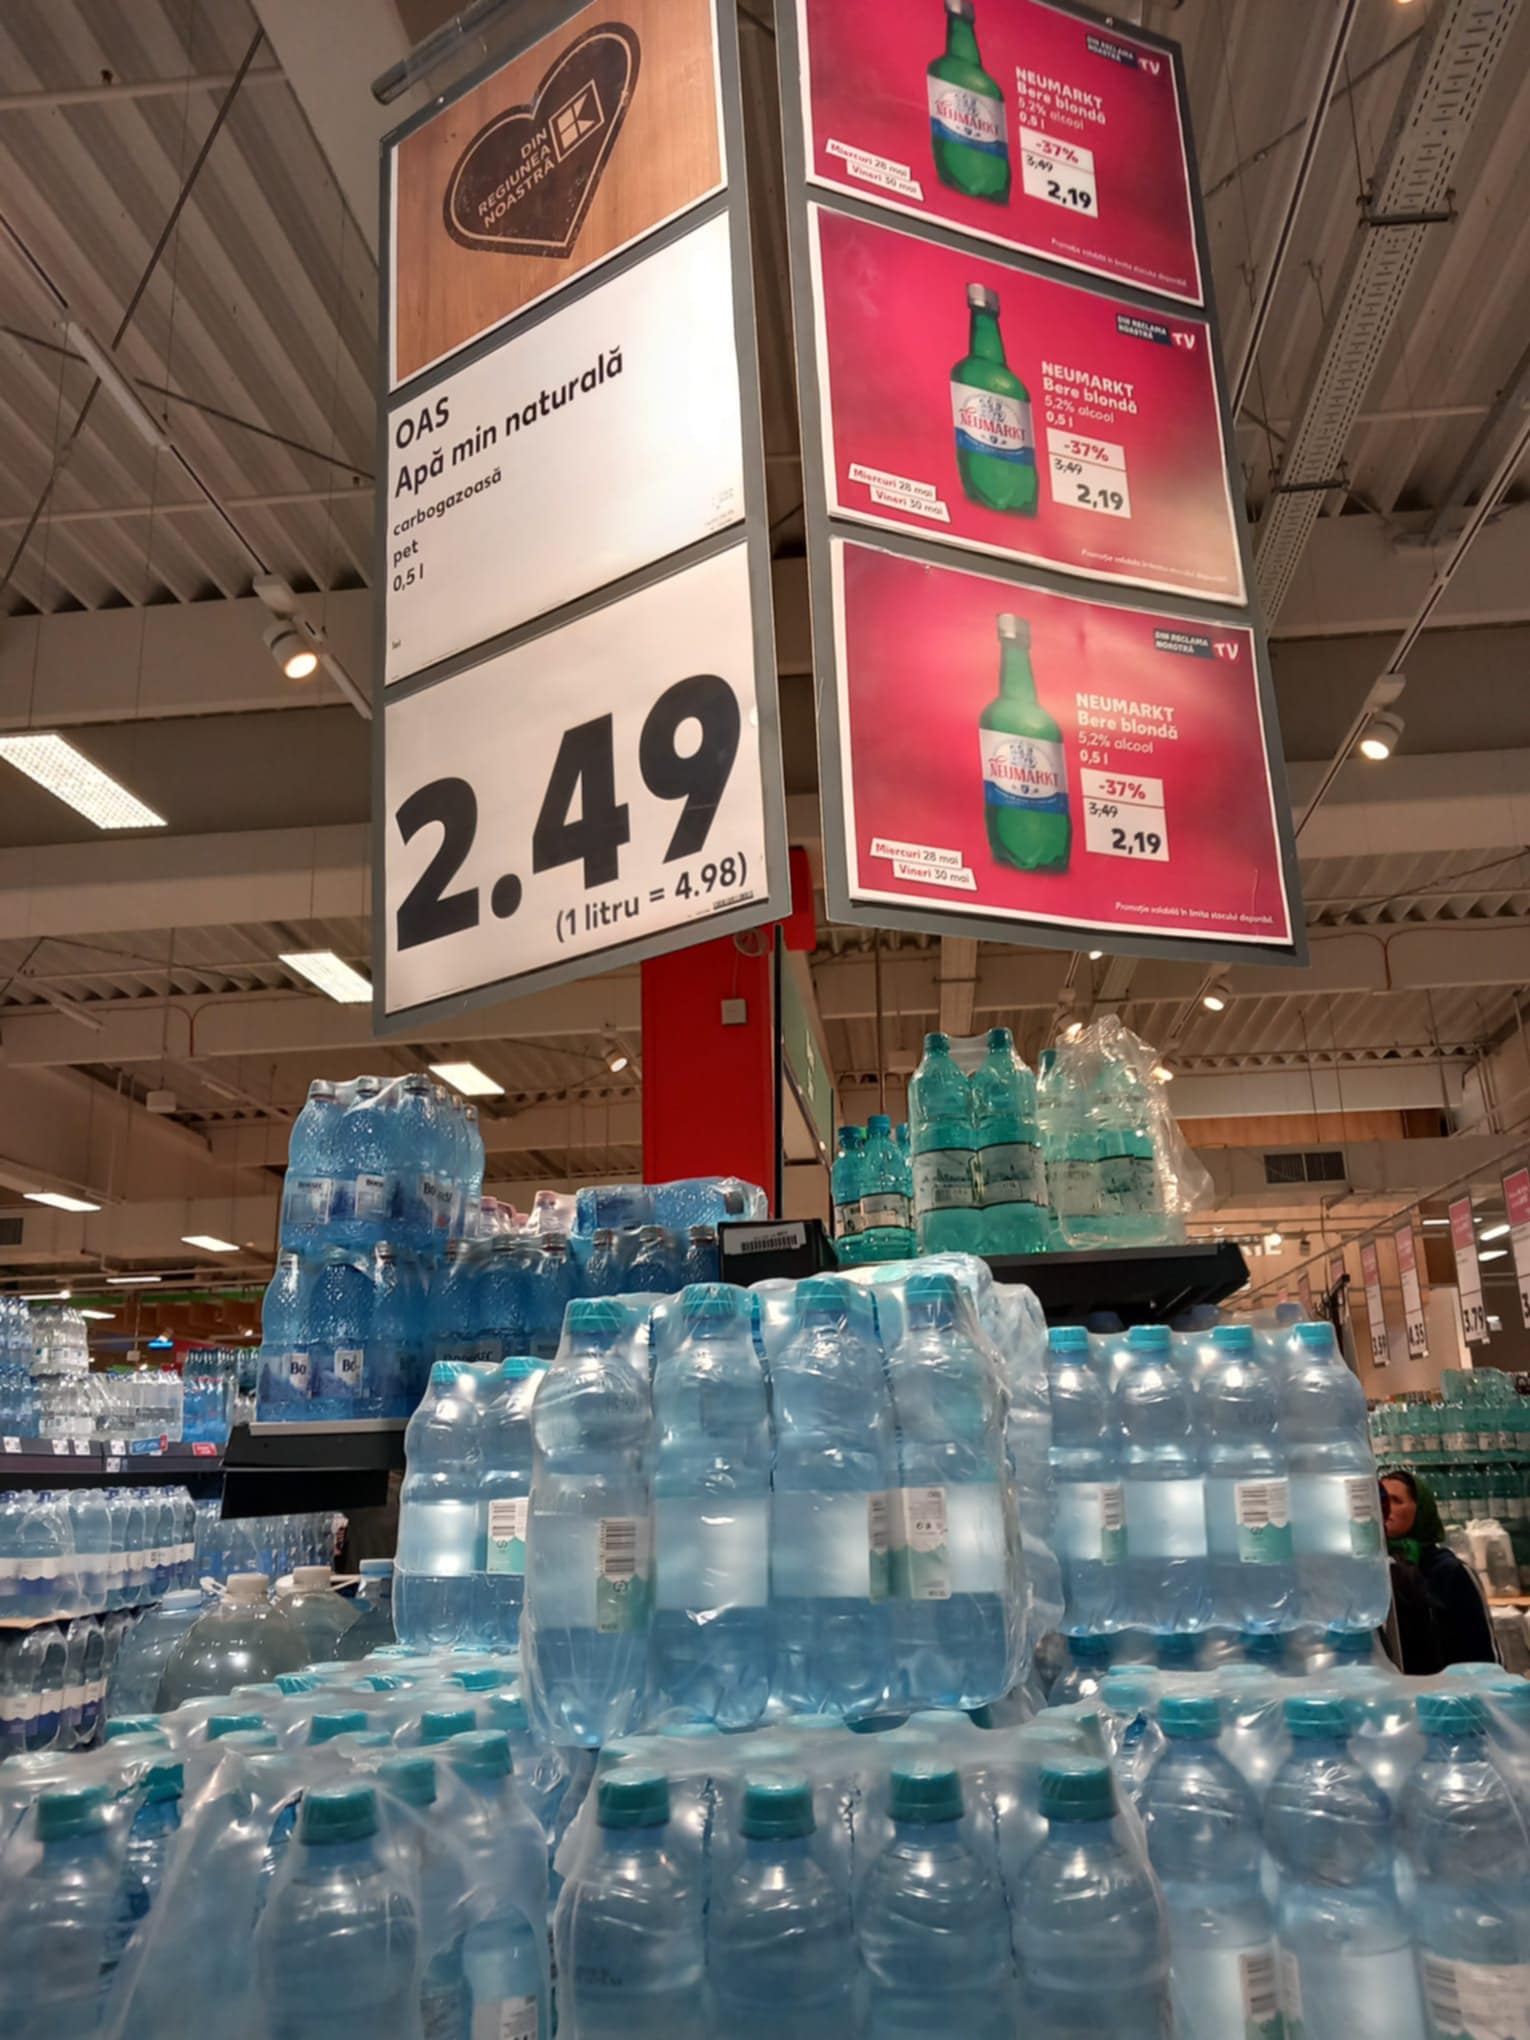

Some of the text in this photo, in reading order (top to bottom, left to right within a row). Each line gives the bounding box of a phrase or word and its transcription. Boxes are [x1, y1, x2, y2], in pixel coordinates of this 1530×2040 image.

[1138, 58, 1160, 75] TV
[1016, 66, 1103, 109] NEUMARKT
[1017, 81, 1051, 103] Bere
[520, 128, 547, 159] DIN
[1035, 139, 1079, 164] -37%
[478, 144, 551, 216] REGIUNEA
[1047, 180, 1091, 209] 2,19
[1171, 333, 1195, 350] TV
[1042, 361, 1134, 398] NEUMARKT
[1043, 377, 1080, 399] Bere
[395, 345, 624, 498] Apă min naturală
[1044, 395, 1114, 423] 5,2% alcool
[1046, 411, 1066, 426] 0,5
[396, 397, 449, 449] OAS
[1064, 440, 1109, 462] -37%
[853, 468, 934, 498] Miercuri 28 mai
[393, 468, 502, 536] carbogazoasă
[876, 490, 944, 515] Vineri 30 mai
[1076, 484, 1124, 511] 2,19
[393, 540, 419, 568] pet
[393, 568, 415, 591] 0,5
[1213, 643, 1239, 661] TV
[1076, 692, 1174, 722] NEUMARKT
[1077, 710, 1178, 740] Bere blondă
[1078, 731, 1153, 754] 5,2% alcool
[1079, 749, 1101, 765] 0,5
[1098, 779, 1146, 800] -37%
[395, 674, 741, 951] 2.49
[1088, 801, 1118, 818] 3,49
[875, 843, 959, 865] Miercuri 28 mai
[1112, 828, 1161, 855] 2,19
[899, 865, 970, 884] Vineri 30 mai
[556, 909, 576, 943] (1
[585, 897, 639, 931] litru
[675, 851, 747, 899] 4.98)
